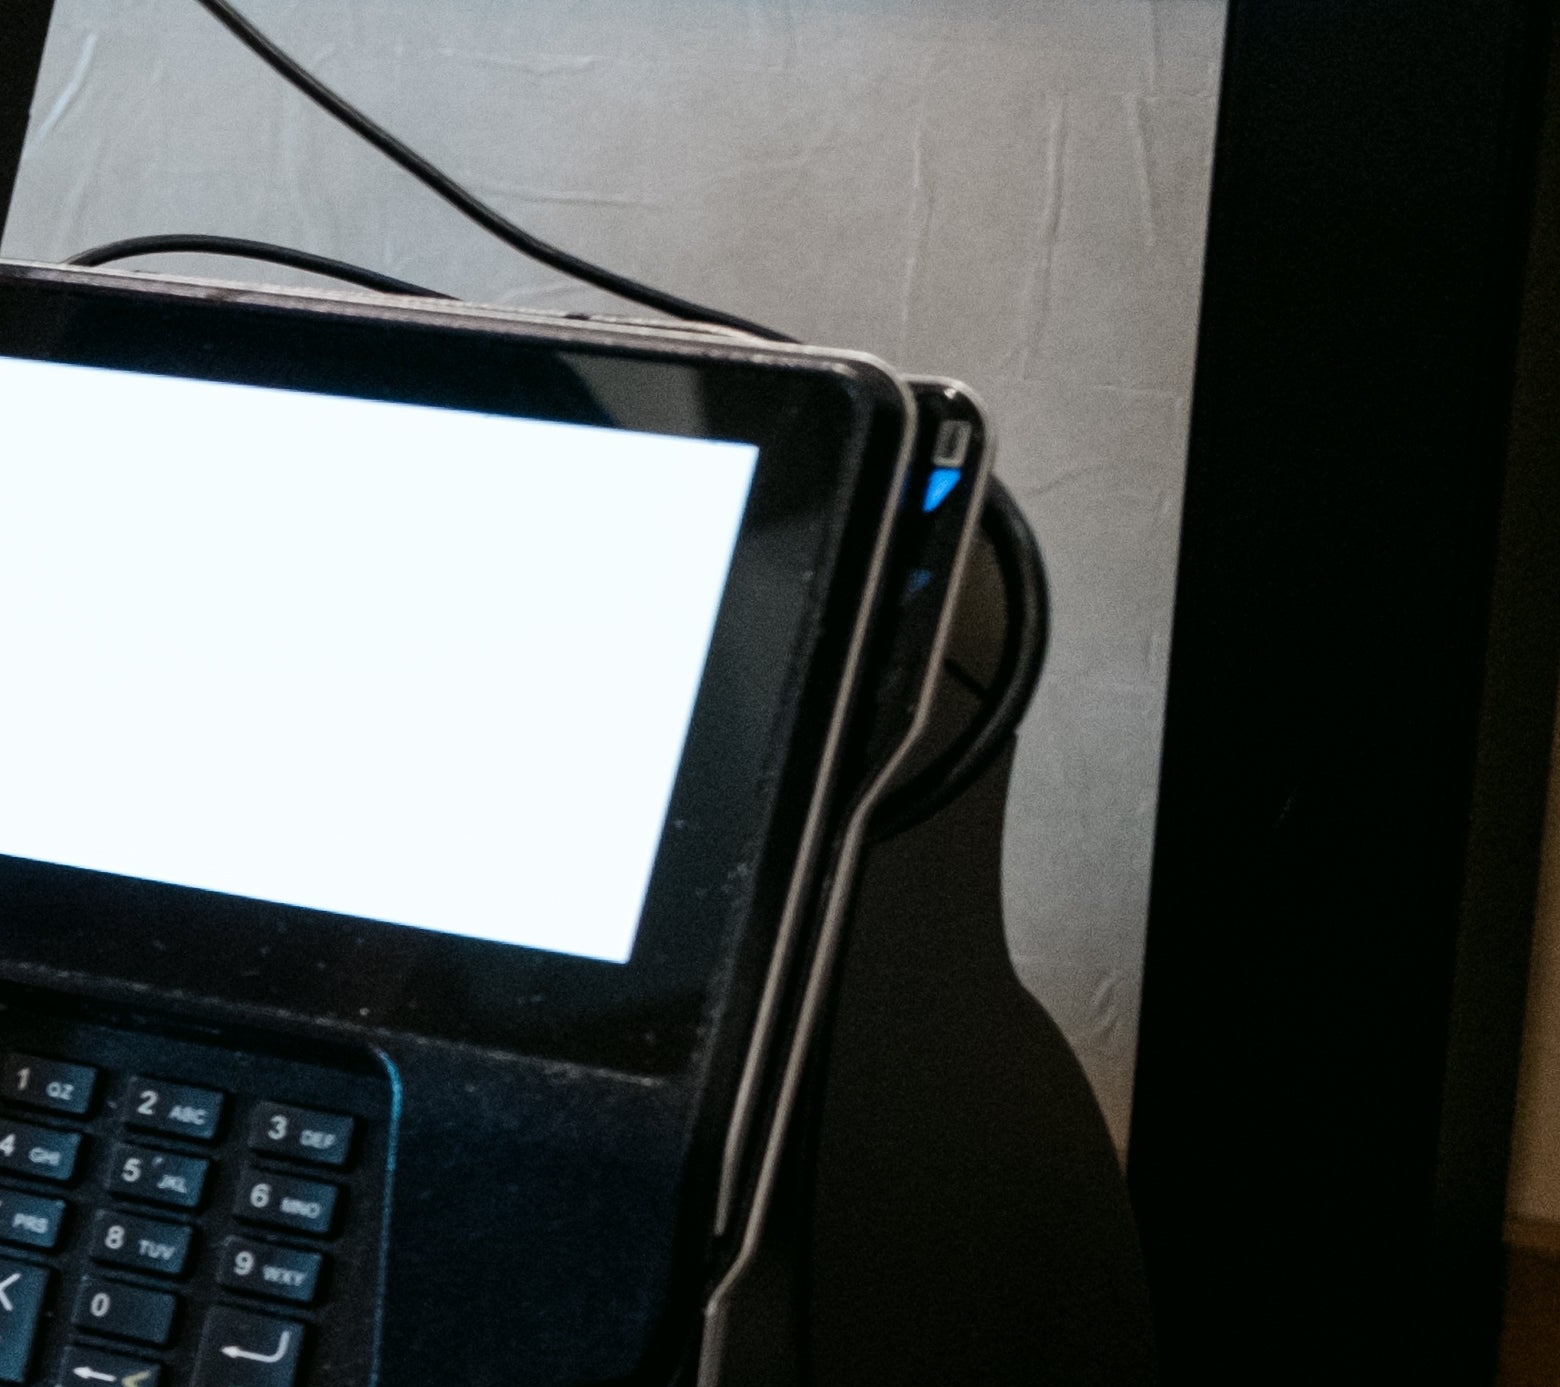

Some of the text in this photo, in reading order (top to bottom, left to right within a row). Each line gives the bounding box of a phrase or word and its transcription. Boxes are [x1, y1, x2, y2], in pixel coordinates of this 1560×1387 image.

[16, 1067, 74, 1101] 1 QZ
[136, 1090, 208, 1125] 2 ABC
[267, 1114, 288, 1140] 3
[122, 1157, 143, 1183] 5
[249, 1182, 271, 1208] 6
[104, 1225, 176, 1260] 8 TUV
[233, 1251, 307, 1287] 9 WXY
[90, 1292, 110, 1317] 0
